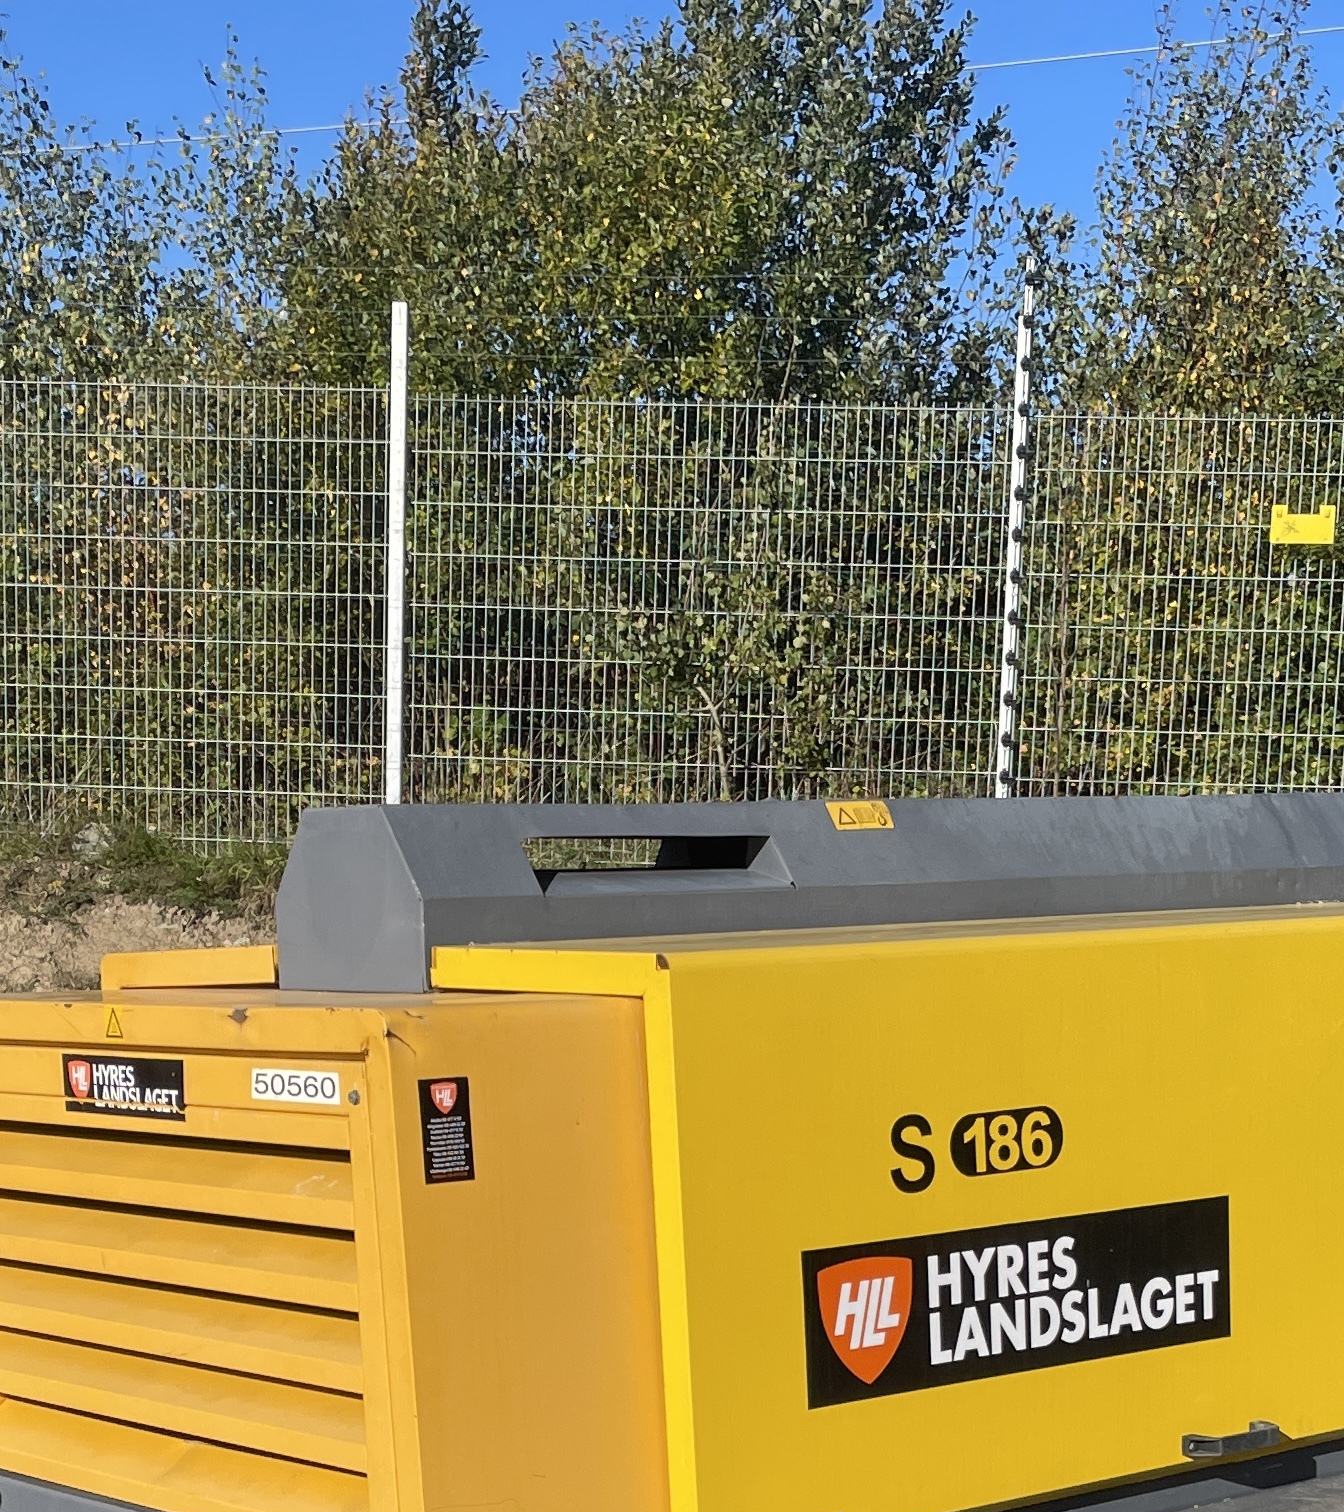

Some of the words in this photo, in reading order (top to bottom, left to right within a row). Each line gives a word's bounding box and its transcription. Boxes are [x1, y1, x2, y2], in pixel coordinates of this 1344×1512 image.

[92, 1063, 135, 1087] HYRES
[94, 1085, 179, 1113] LANDSLAGET
[254, 1073, 336, 1099] 50560
[890, 1113, 935, 1194] S
[963, 1110, 1054, 1173] 186
[927, 1235, 1078, 1309] HYRES
[834, 1275, 901, 1350] HLL
[929, 1268, 1220, 1366] LANDSLAGET
